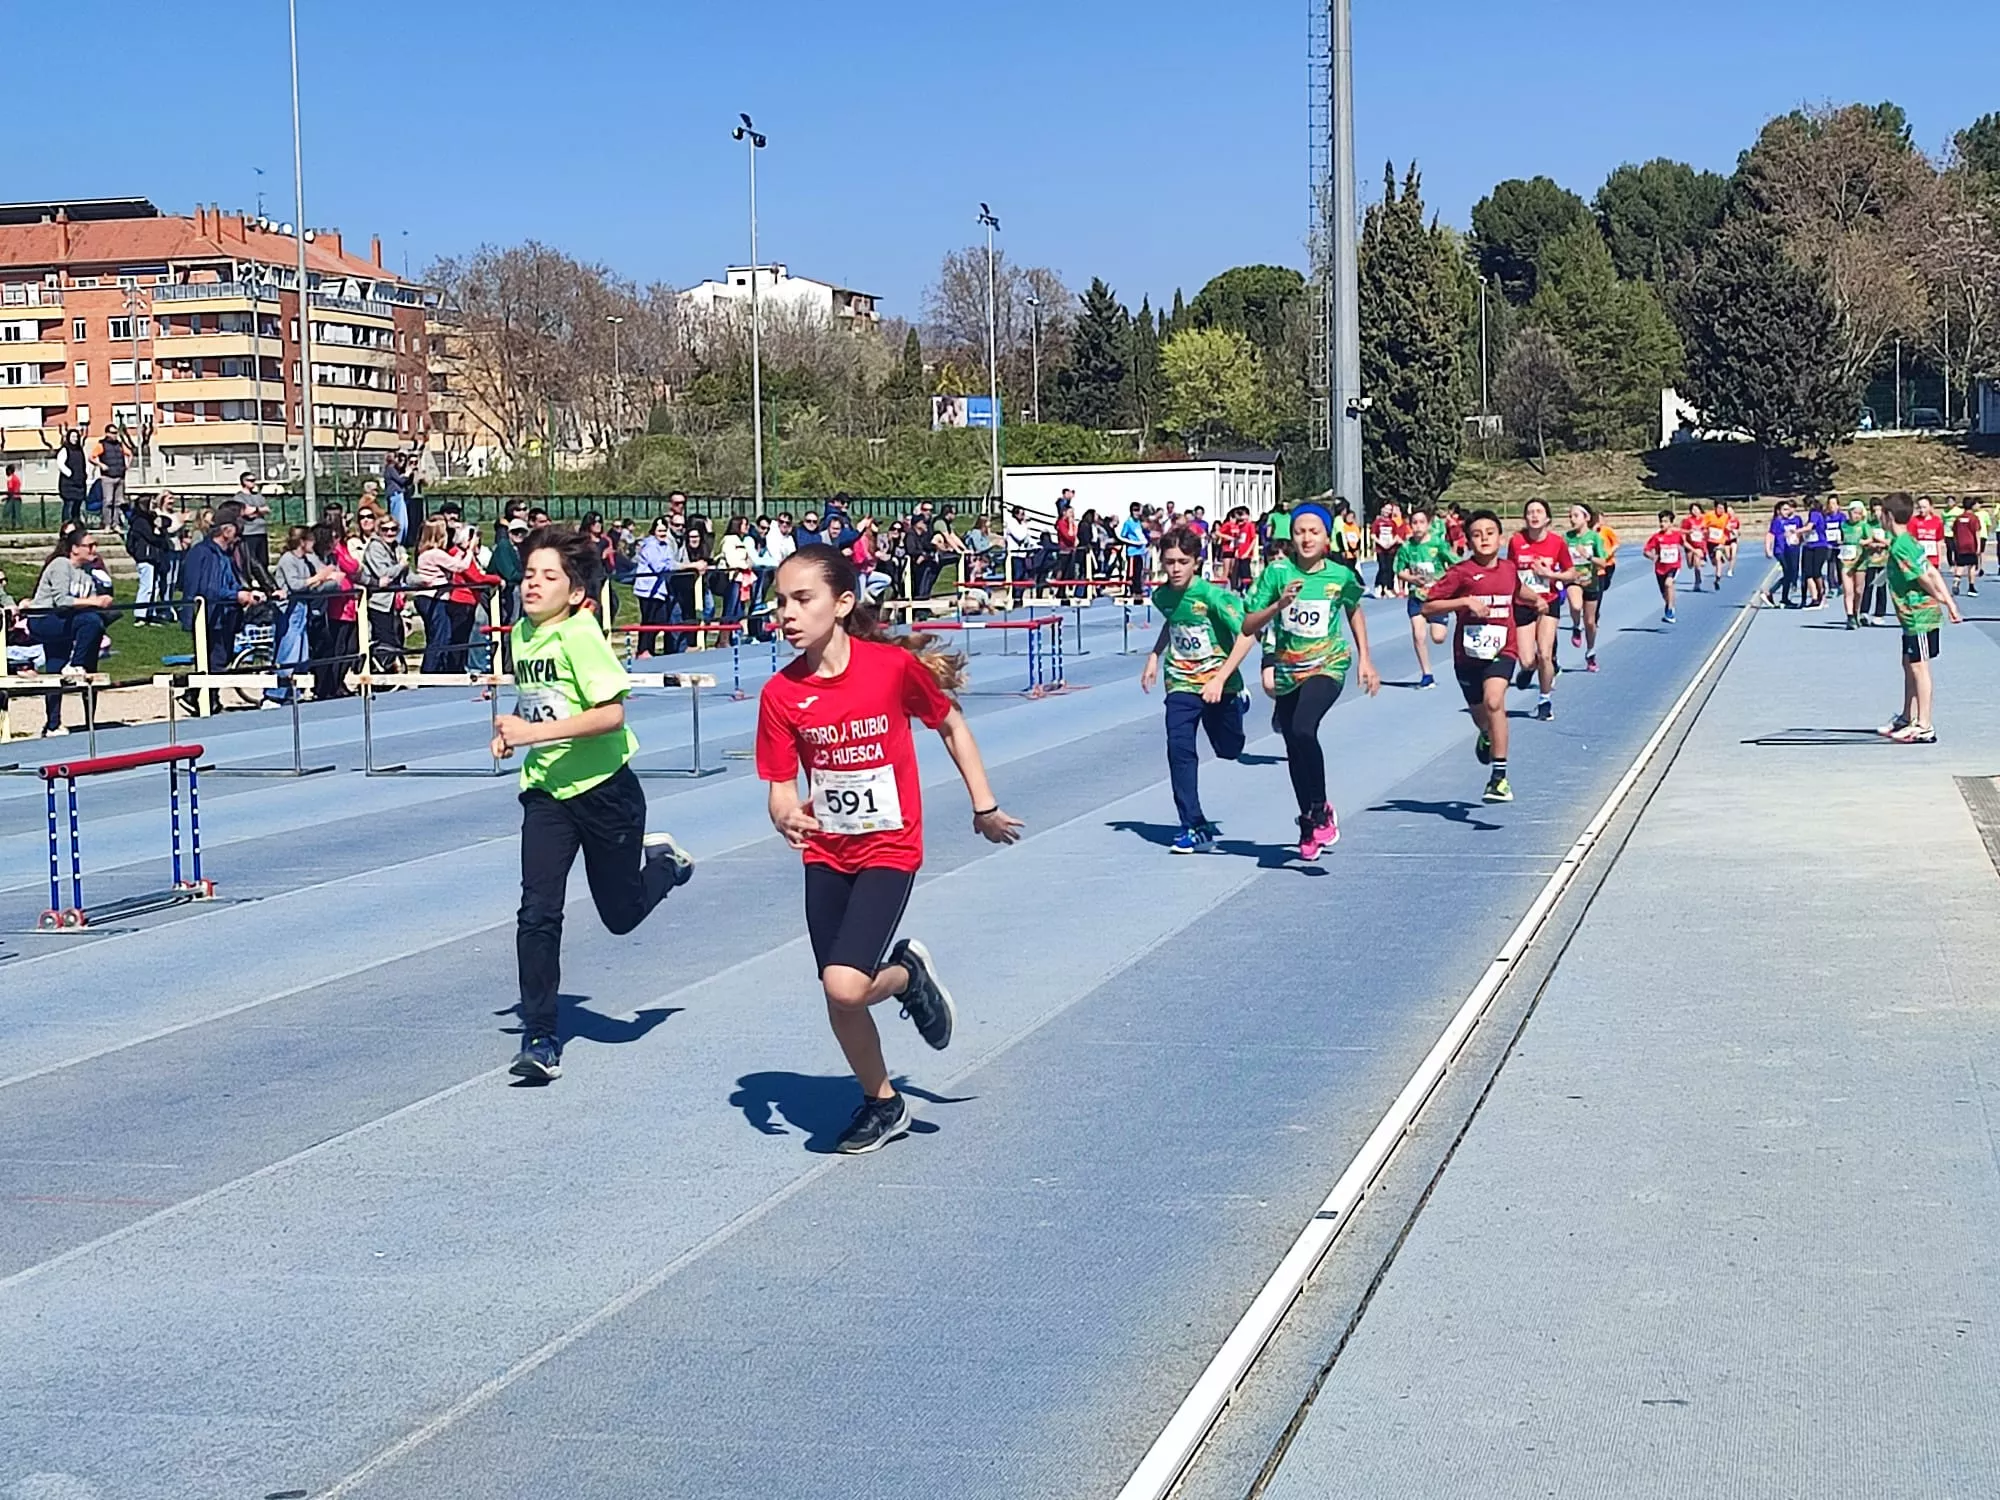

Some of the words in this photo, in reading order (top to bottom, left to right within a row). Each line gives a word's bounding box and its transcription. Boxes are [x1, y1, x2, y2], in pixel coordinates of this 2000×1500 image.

[1288, 607, 1320, 626] 509
[1472, 635, 1501, 648] 528
[850, 714, 889, 739] RUBIO
[832, 742, 884, 765] HUESCA
[824, 788, 879, 815] 591
